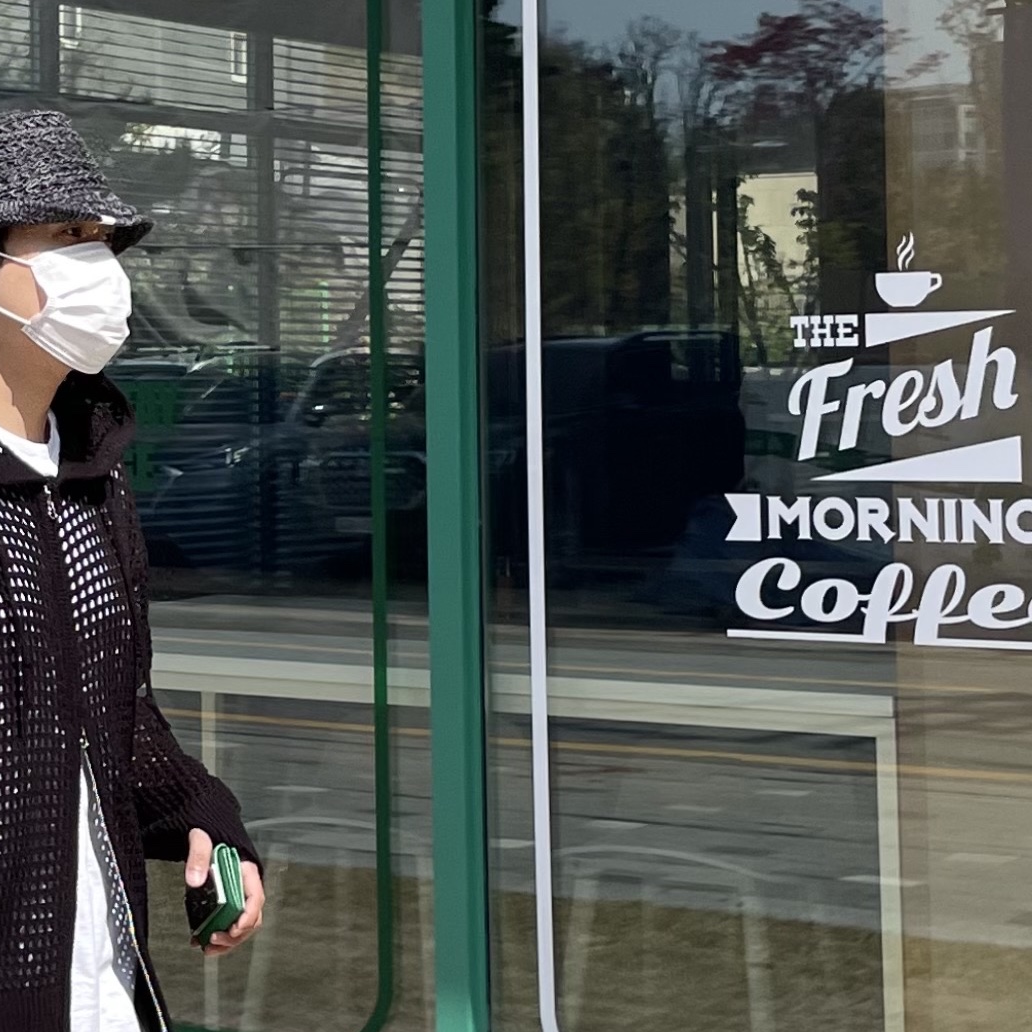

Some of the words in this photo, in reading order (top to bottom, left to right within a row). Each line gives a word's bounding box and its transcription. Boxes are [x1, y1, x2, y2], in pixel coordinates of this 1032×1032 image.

[789, 315, 859, 347] THE
[788, 326, 1019, 461] Fresh
[734, 557, 1032, 644] Coffe
